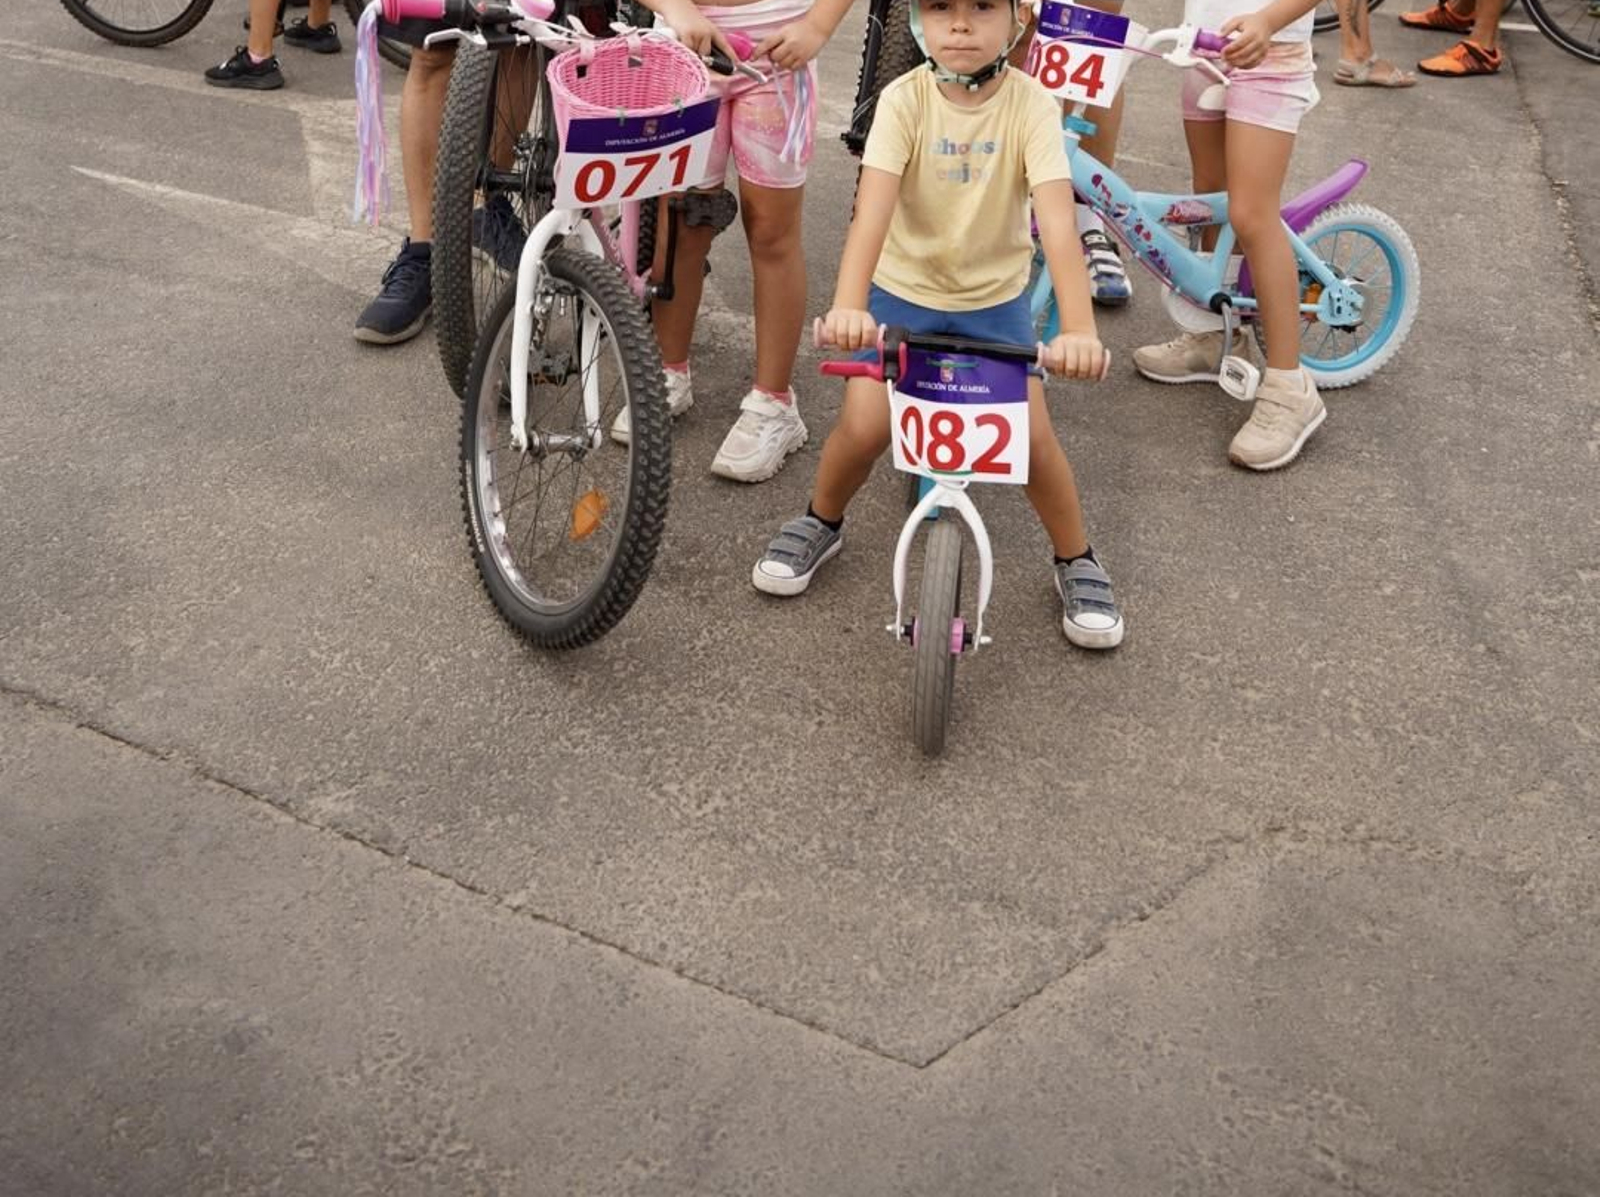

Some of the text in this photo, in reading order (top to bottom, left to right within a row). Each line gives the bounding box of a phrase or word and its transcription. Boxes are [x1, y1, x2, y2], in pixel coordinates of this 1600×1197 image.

[574, 144, 692, 203] 071
[948, 384, 957, 392] DE
[901, 405, 1012, 475] 082
